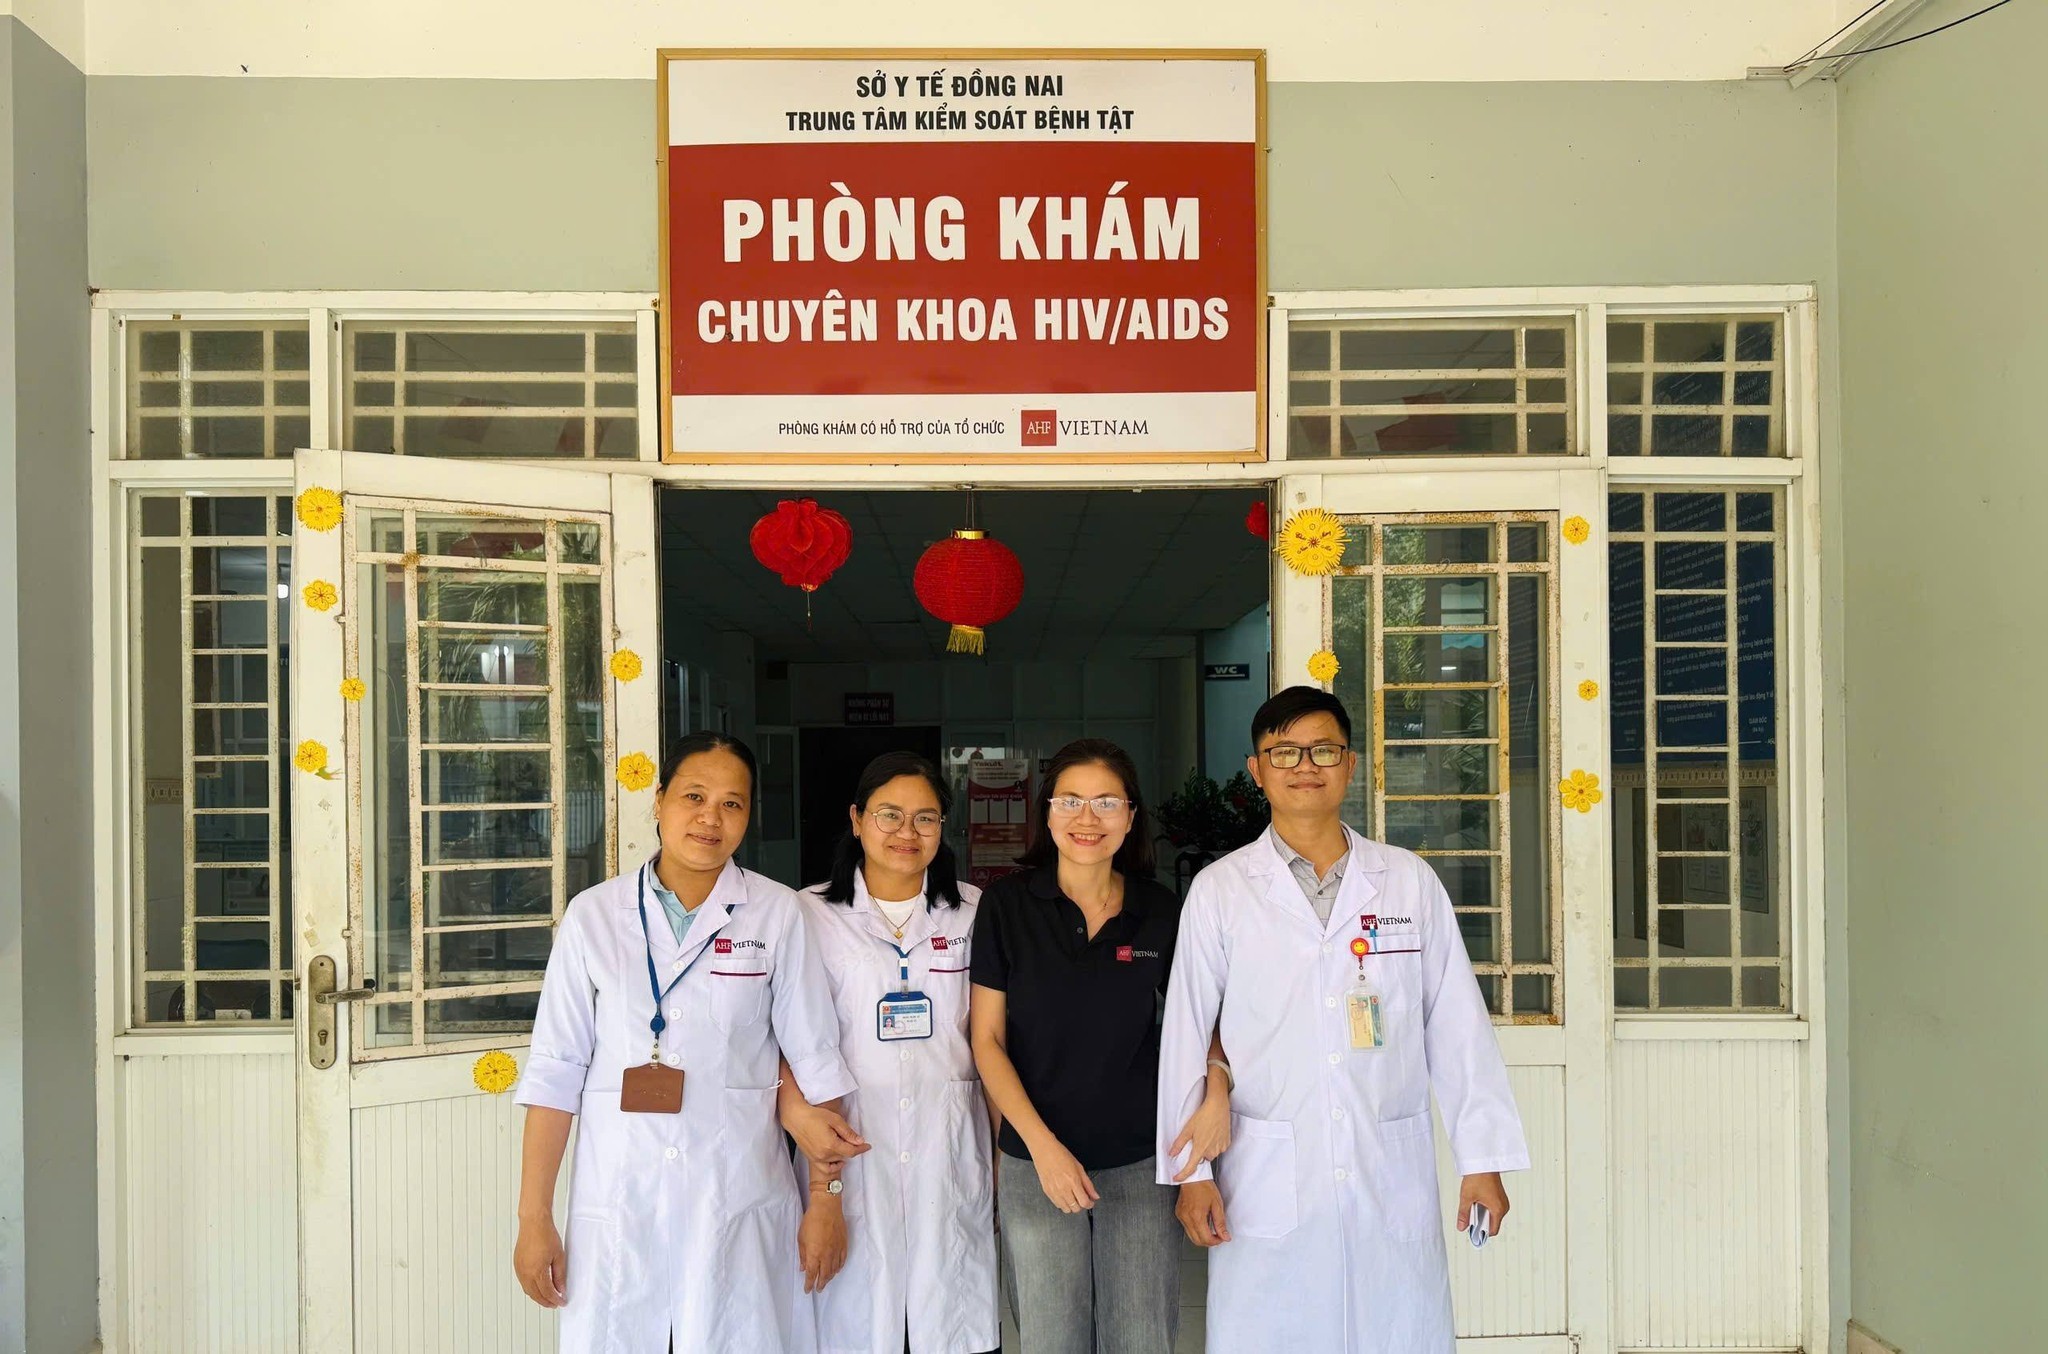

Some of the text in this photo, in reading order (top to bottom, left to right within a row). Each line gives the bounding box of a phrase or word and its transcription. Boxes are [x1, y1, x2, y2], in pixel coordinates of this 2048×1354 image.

[857, 68, 1062, 97] SỞ Y TẾ ĐỒNG NAI
[786, 102, 1134, 134] TRUNG TÂM KIỂM SOÁT BỆNH TẬT
[724, 181, 1199, 262] PHÒNG KHÁM
[699, 289, 1228, 344] CHUYÊN KHOA HIV/AIDS
[779, 418, 1004, 436] PHÒNG KHÁM CÓ HỖ TRỢ CỦA TỔ CHỨC
[1027, 420, 1148, 435] AHF VIETNAM
[1214, 666, 1238, 674] WC
[1377, 917, 1412, 925] VIETNAM
[716, 942, 731, 950] AHF
[1131, 950, 1159, 958] VIETNAM
